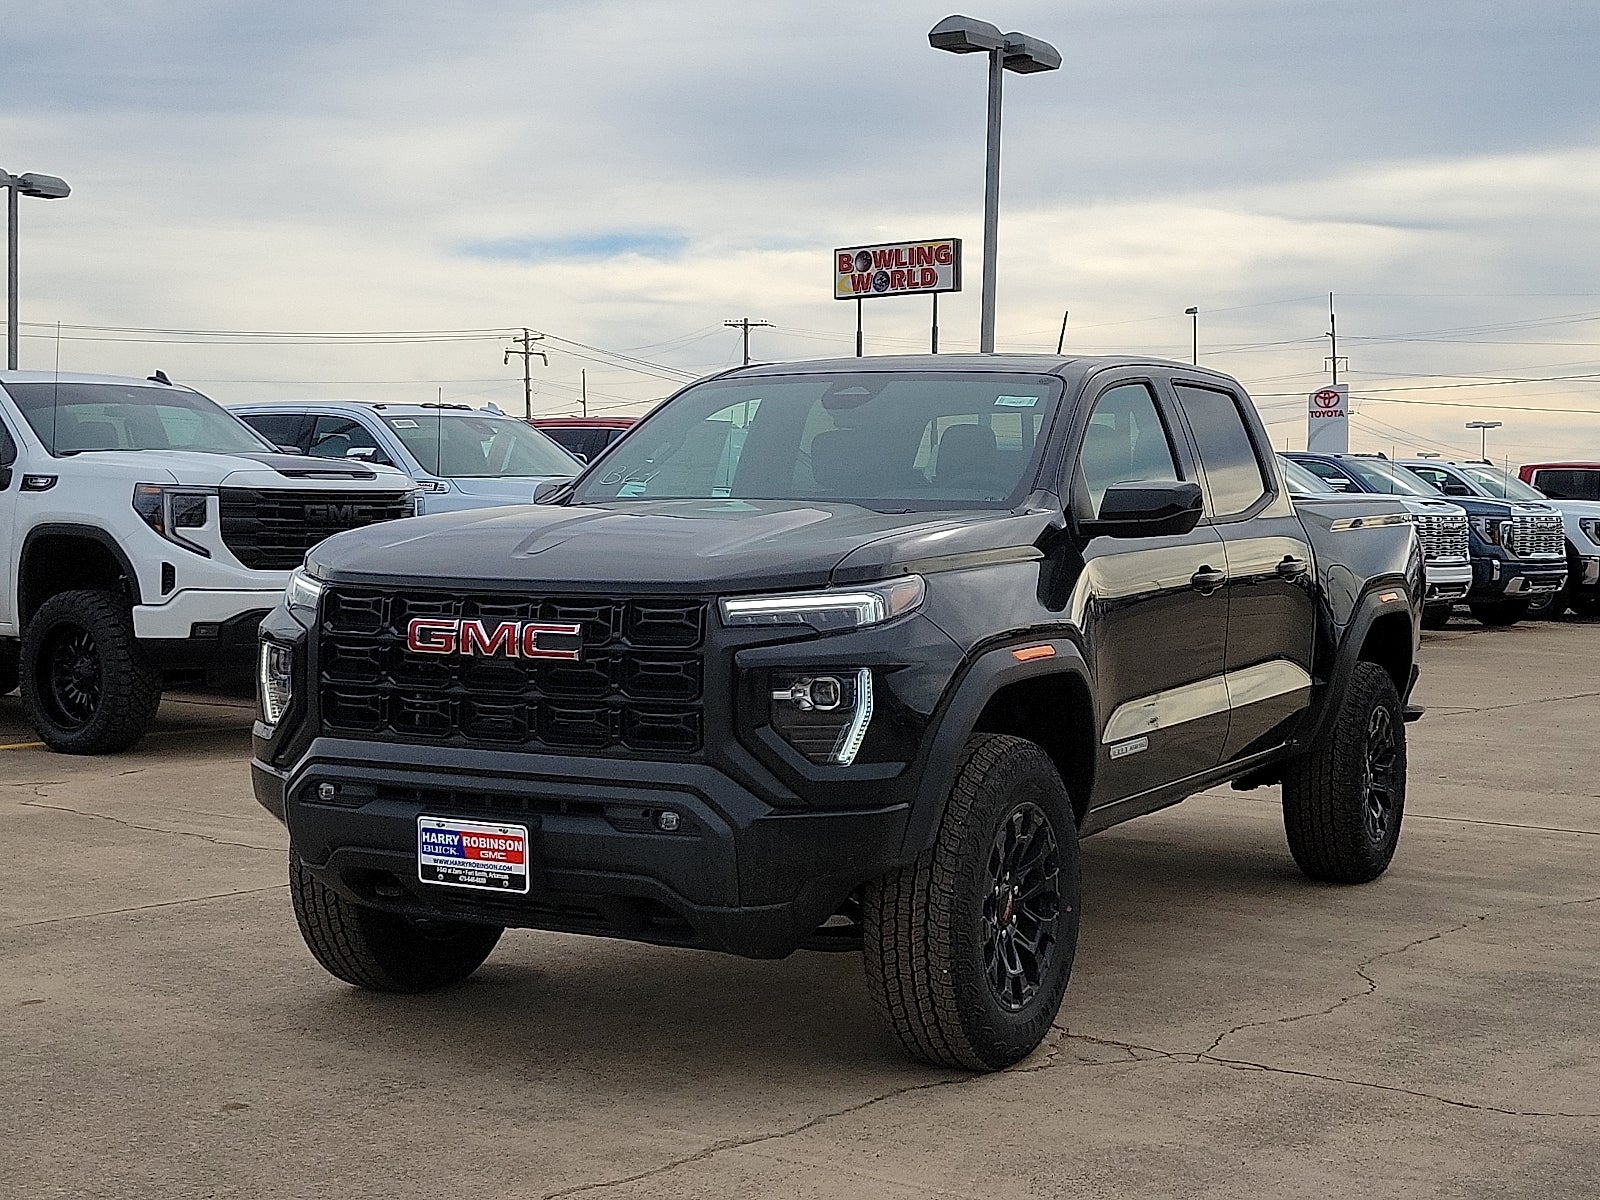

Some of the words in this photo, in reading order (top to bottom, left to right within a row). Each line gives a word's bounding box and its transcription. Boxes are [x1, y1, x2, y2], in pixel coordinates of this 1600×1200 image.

[838, 244, 953, 274] BOWLING
[850, 267, 939, 294] WORLD
[1309, 410, 1345, 418] TOYOTA
[304, 504, 373, 523] GMC
[407, 617, 581, 661] GMC
[422, 831, 460, 846] HARRY
[462, 835, 523, 852] ROBINSON
[422, 844, 457, 855] BUICK
[480, 850, 507, 860] GMC
